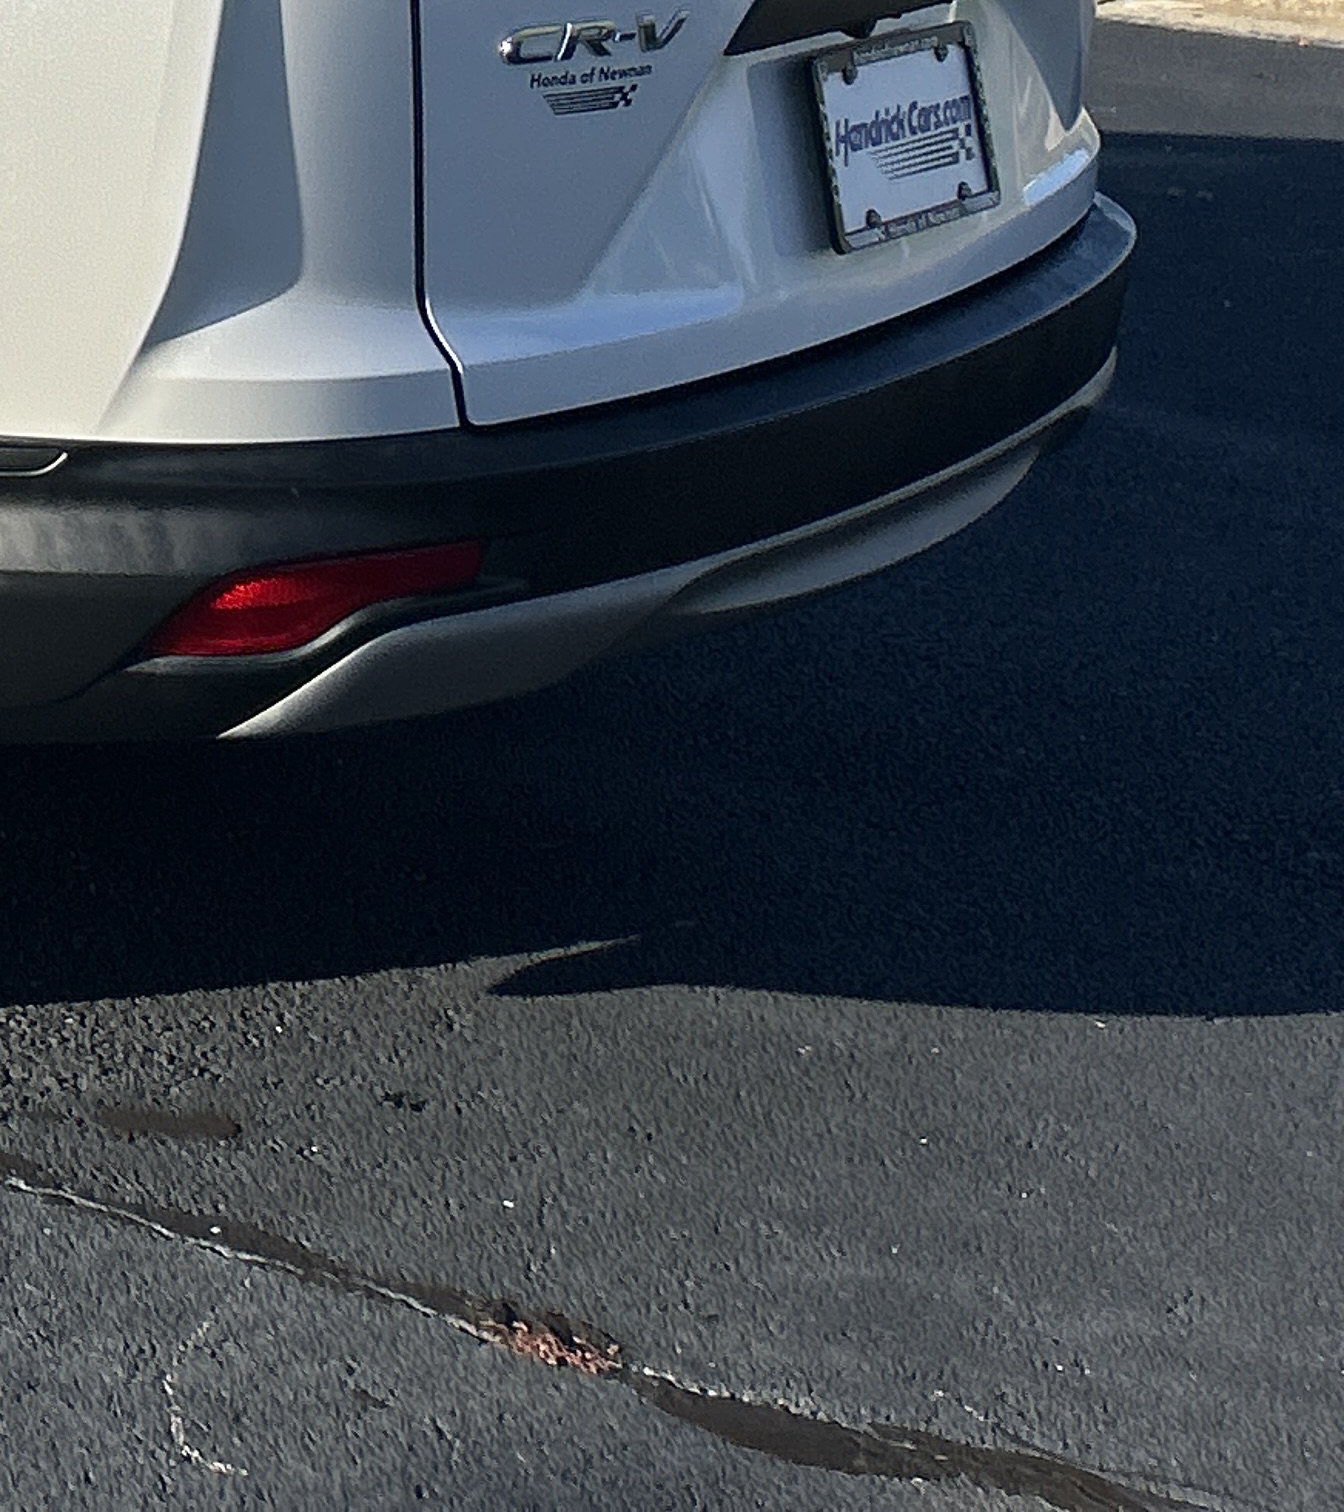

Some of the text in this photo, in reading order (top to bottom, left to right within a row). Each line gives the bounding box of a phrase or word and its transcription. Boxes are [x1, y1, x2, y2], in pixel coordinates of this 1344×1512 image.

[498, 9, 691, 65] CR-V
[530, 71, 577, 88] Honda
[580, 66, 597, 84] of
